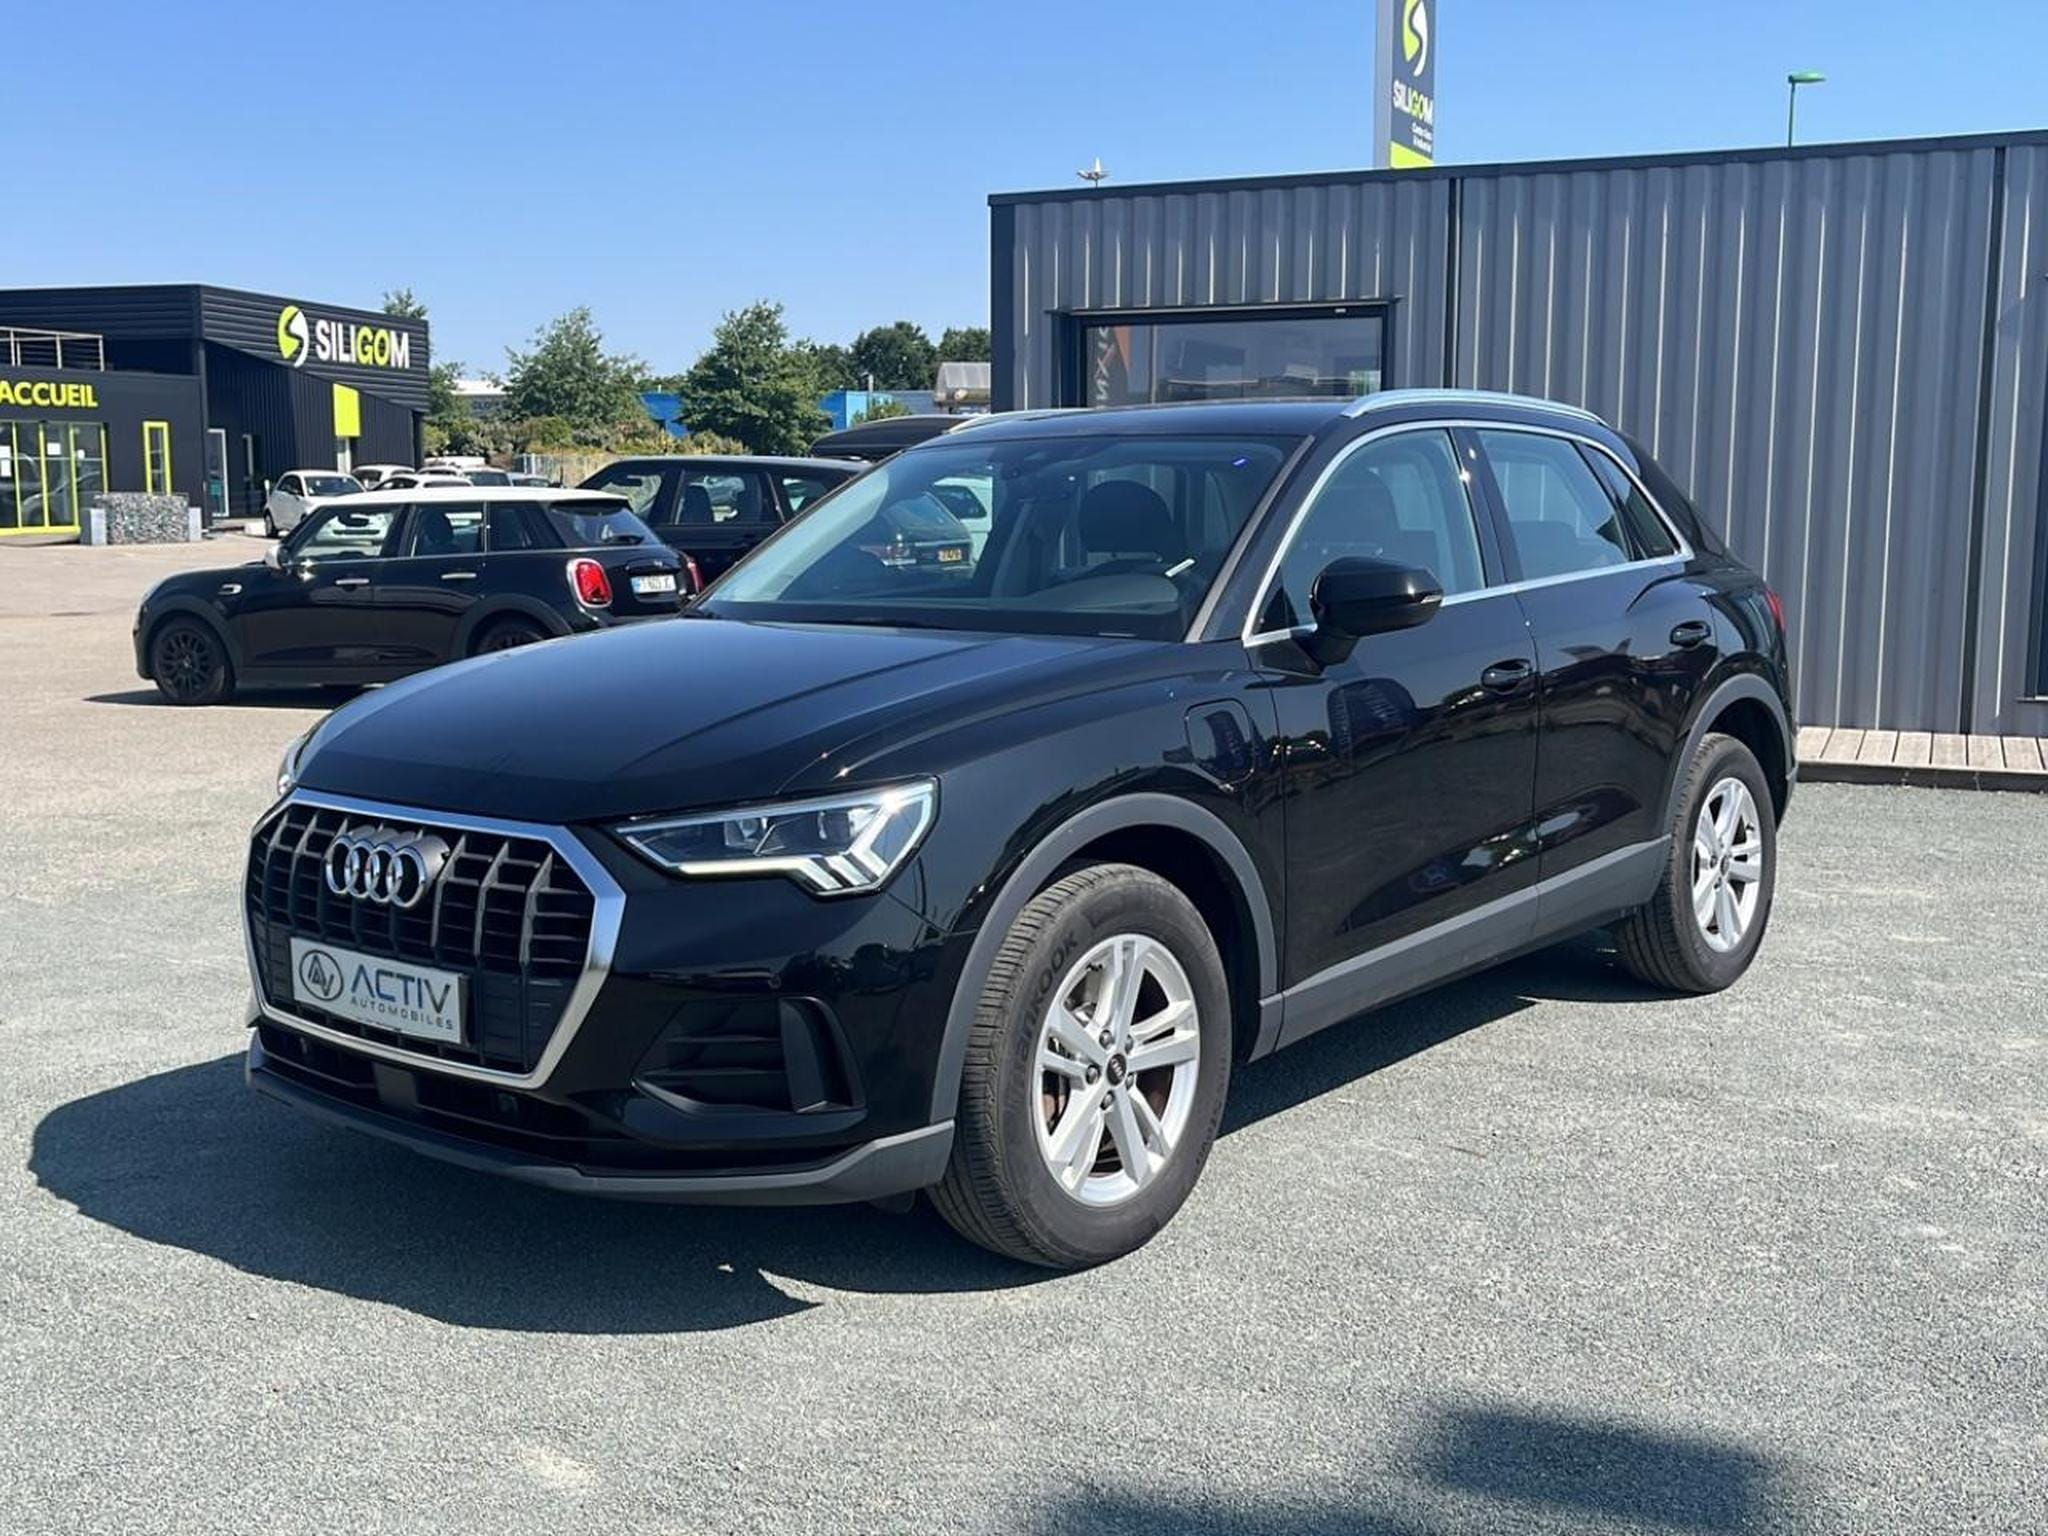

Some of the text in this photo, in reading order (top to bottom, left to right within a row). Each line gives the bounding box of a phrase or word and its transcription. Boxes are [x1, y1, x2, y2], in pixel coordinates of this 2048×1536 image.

[1393, 80, 1433, 127] SILIGOM
[315, 319, 410, 369] SILIGOM
[0, 380, 98, 408] ACCUEIL
[351, 963, 451, 1015] ACTIV
[350, 997, 454, 1030] AUTOMOBILES
